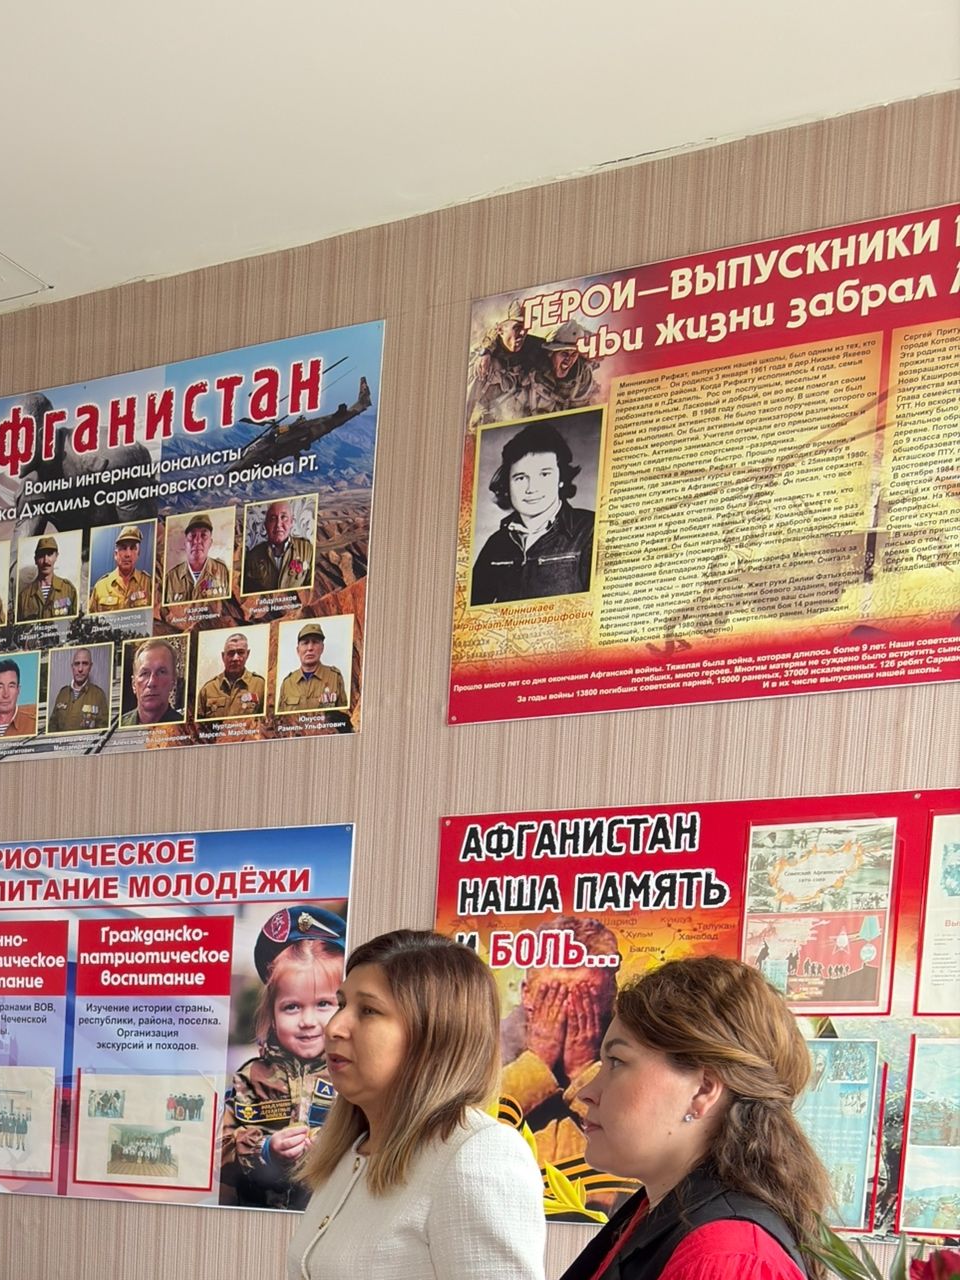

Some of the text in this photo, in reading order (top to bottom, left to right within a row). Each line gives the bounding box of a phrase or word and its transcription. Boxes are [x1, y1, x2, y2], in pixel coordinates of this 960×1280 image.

[577, 272, 938, 359] чьи жизни забрал
[904, 330, 932, 342] Сергей
[661, 372, 689, 381] Рифкат,
[733, 359, 757, 369] нашей
[759, 356, 787, 365] школы,
[789, 352, 806, 360] был
[808, 348, 833, 357] одним
[899, 362, 959, 376] возвращаются
[25, 447, 242, 496] Воины интернационалисты
[19, 496, 90, 520] Джалиль
[93, 474, 224, 507] Сармановского
[228, 462, 294, 488] района
[298, 454, 319, 472] РТ.
[500, 602, 555, 616] Минникаев
[590, 667, 633, 679] Афганской
[666, 661, 700, 671] Тяжелая
[703, 659, 725, 667] была
[727, 656, 755, 665] война,
[757, 652, 791, 662] которая
[833, 646, 860, 654] более
[889, 640, 914, 648] Наши
[460, 814, 698, 860] АФГАНИСТАН
[128, 866, 310, 899] МОЛОДЁЖИ
[458, 871, 729, 914] НАША ПАМЯТЬ
[100, 925, 209, 944] Гражданско-
[80, 946, 230, 966] патриотическое
[491, 931, 619, 968] БОЛЬ...
[101, 970, 205, 988] воспитание
[34, 1003, 56, 1013] ВОВ,
[87, 1004, 214, 1015] Изучение истории страны,
[1, 1014, 47, 1024] Чеченской
[79, 1015, 221, 1027] республики, района, поселка.
[117, 1028, 178, 1038] Организация
[96, 1040, 143, 1051] экскурсий
[156, 1041, 199, 1051] походов.
